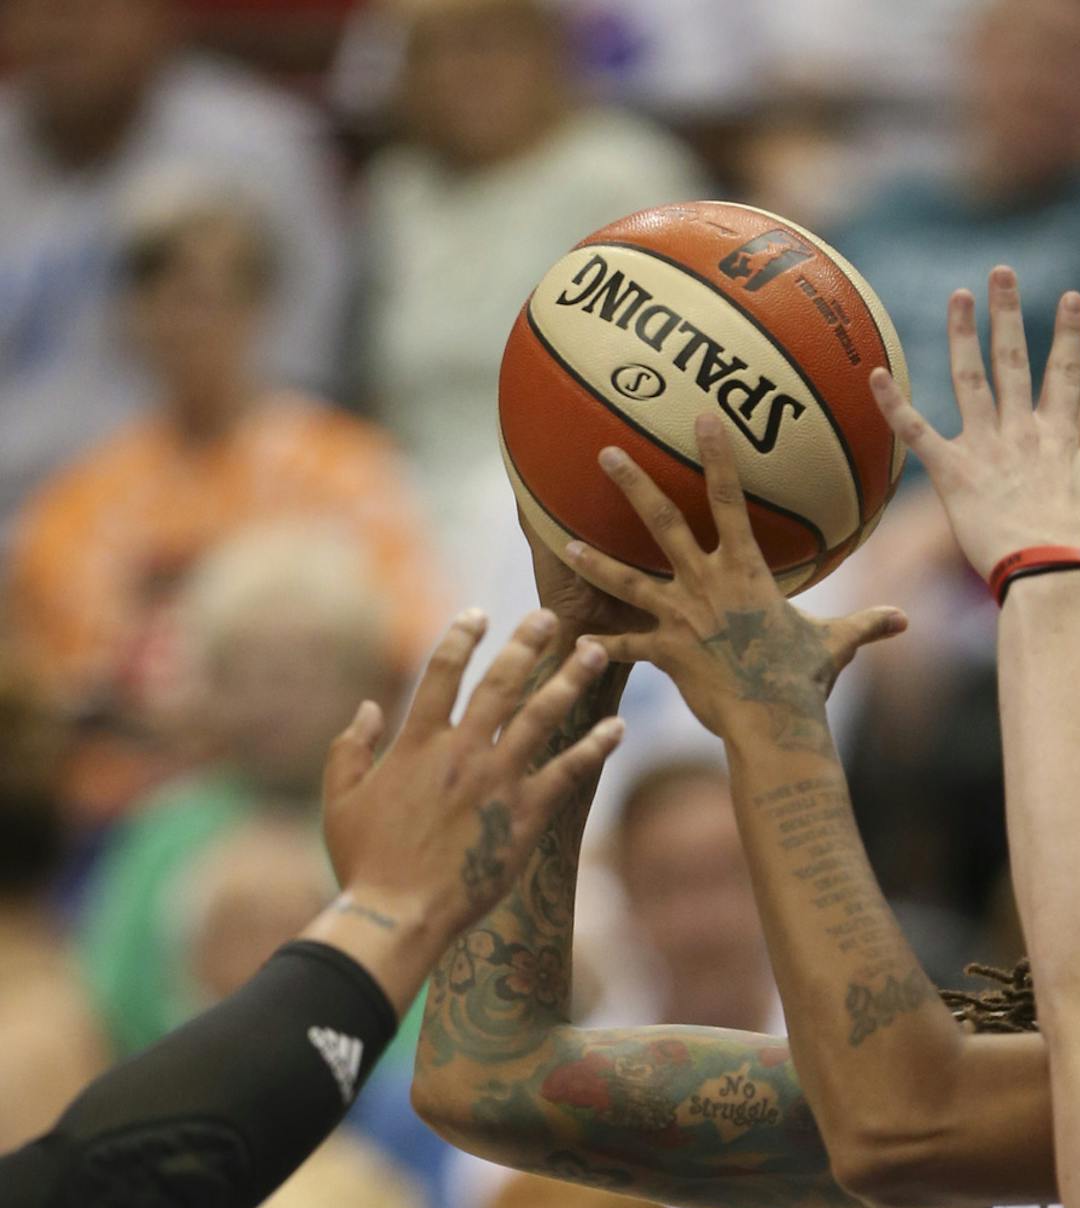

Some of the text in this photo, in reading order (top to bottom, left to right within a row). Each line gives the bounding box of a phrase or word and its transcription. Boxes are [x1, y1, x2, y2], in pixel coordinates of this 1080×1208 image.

[556, 254, 807, 454] SPALDING
[719, 1075, 756, 1100] No
[689, 1095, 779, 1127] Struggle
